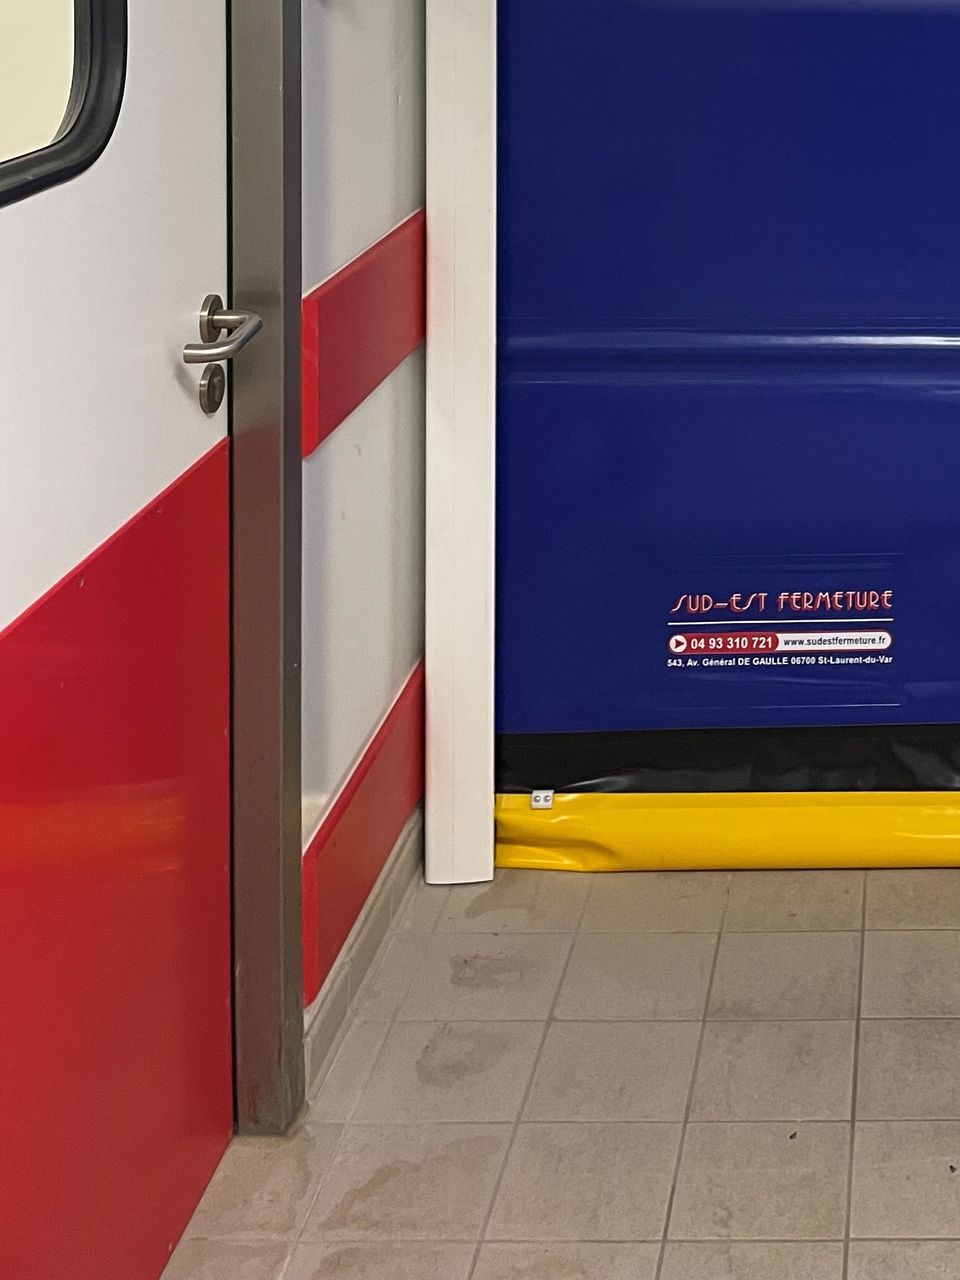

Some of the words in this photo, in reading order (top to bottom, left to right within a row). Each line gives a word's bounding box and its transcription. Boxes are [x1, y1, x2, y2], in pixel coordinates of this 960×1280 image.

[670, 593, 768, 613] SUD-EST
[778, 590, 893, 611] FERMETURE
[690, 639, 706, 650] 04
[708, 638, 723, 649] 93
[726, 637, 748, 649] 310
[751, 637, 773, 649] 721
[783, 636, 886, 646] www.sudestfermeture.fr
[667, 658, 685, 668] 543,
[686, 658, 700, 667] Av.
[702, 657, 736, 667] Général
[737, 657, 751, 666] DE
[752, 656, 789, 666] GAULLE
[790, 656, 816, 665] 06700
[817, 655, 894, 665] St-Laurent-du-Var
